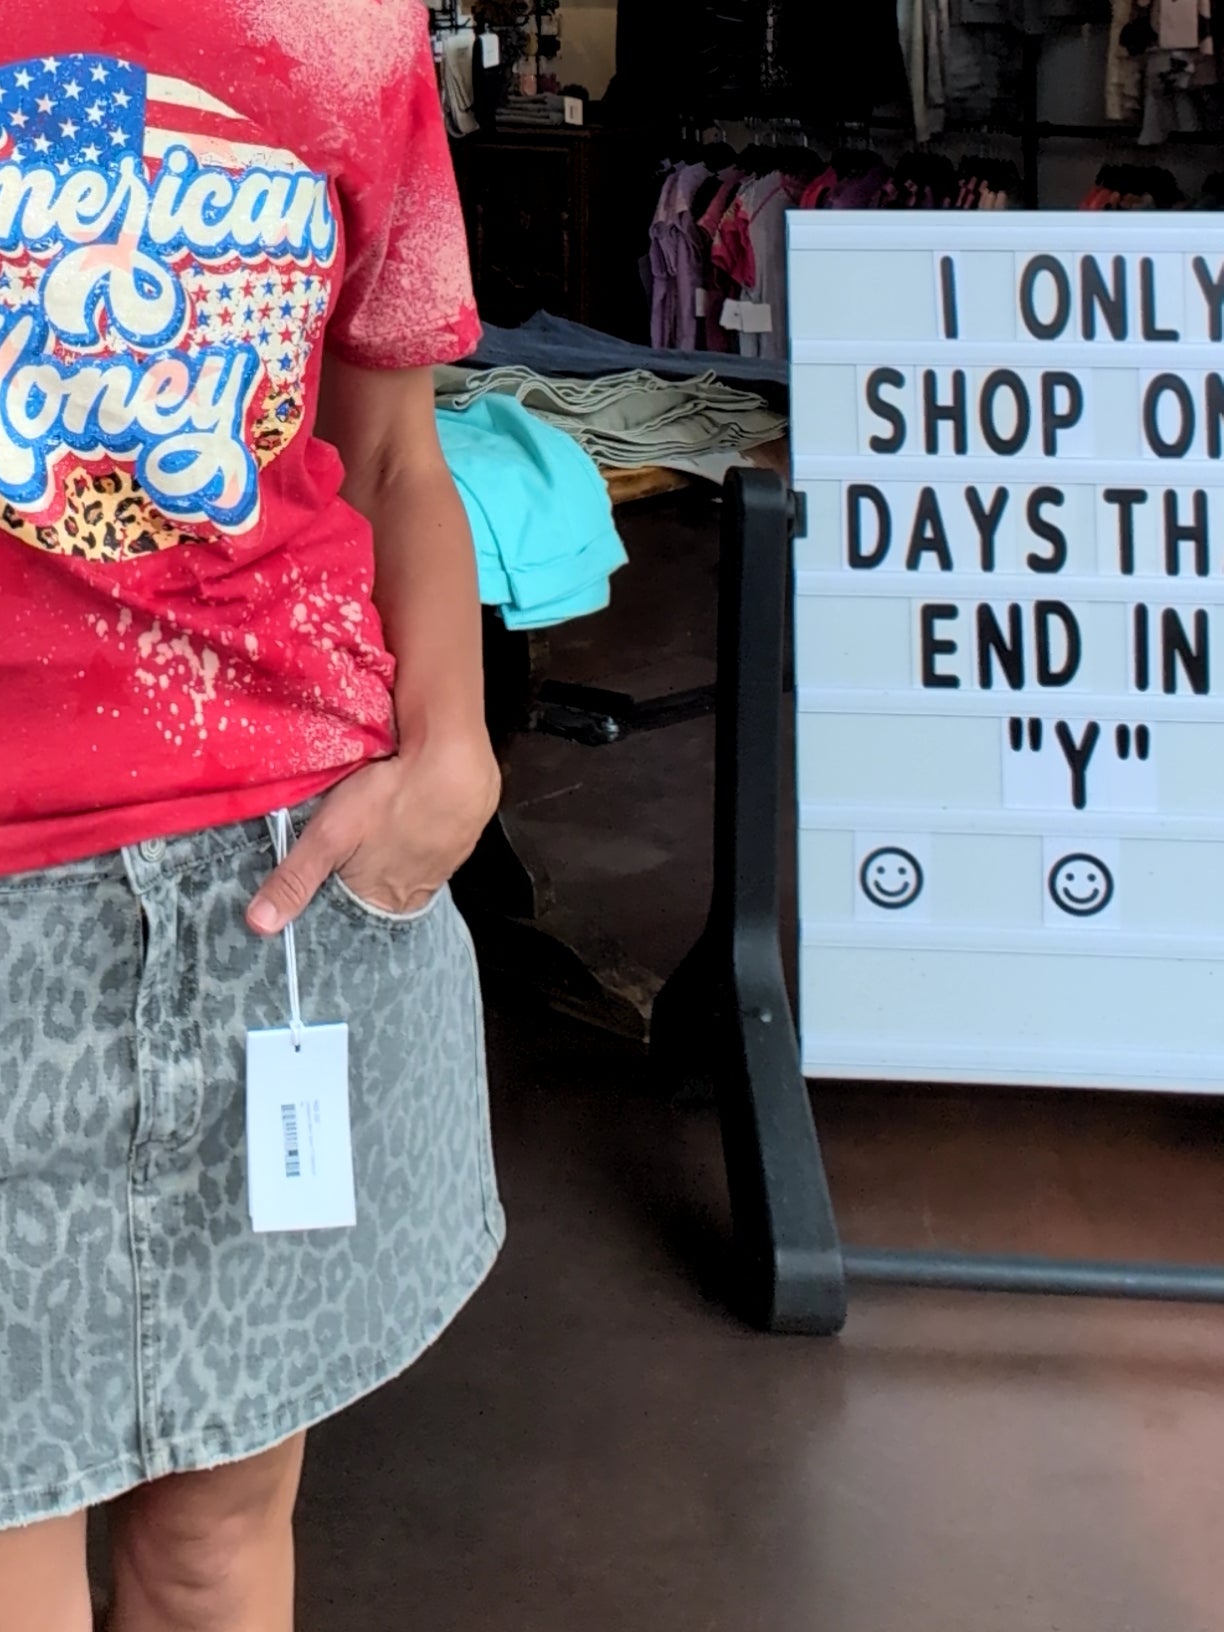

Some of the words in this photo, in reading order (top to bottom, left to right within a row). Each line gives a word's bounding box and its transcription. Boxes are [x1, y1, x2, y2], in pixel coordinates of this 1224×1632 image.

[940, 255, 958, 340] I
[865, 368, 1083, 456] SHOP
[847, 483, 1068, 573] DAYS
[921, 600, 1082, 690] END
[1134, 603, 1210, 695] IN
